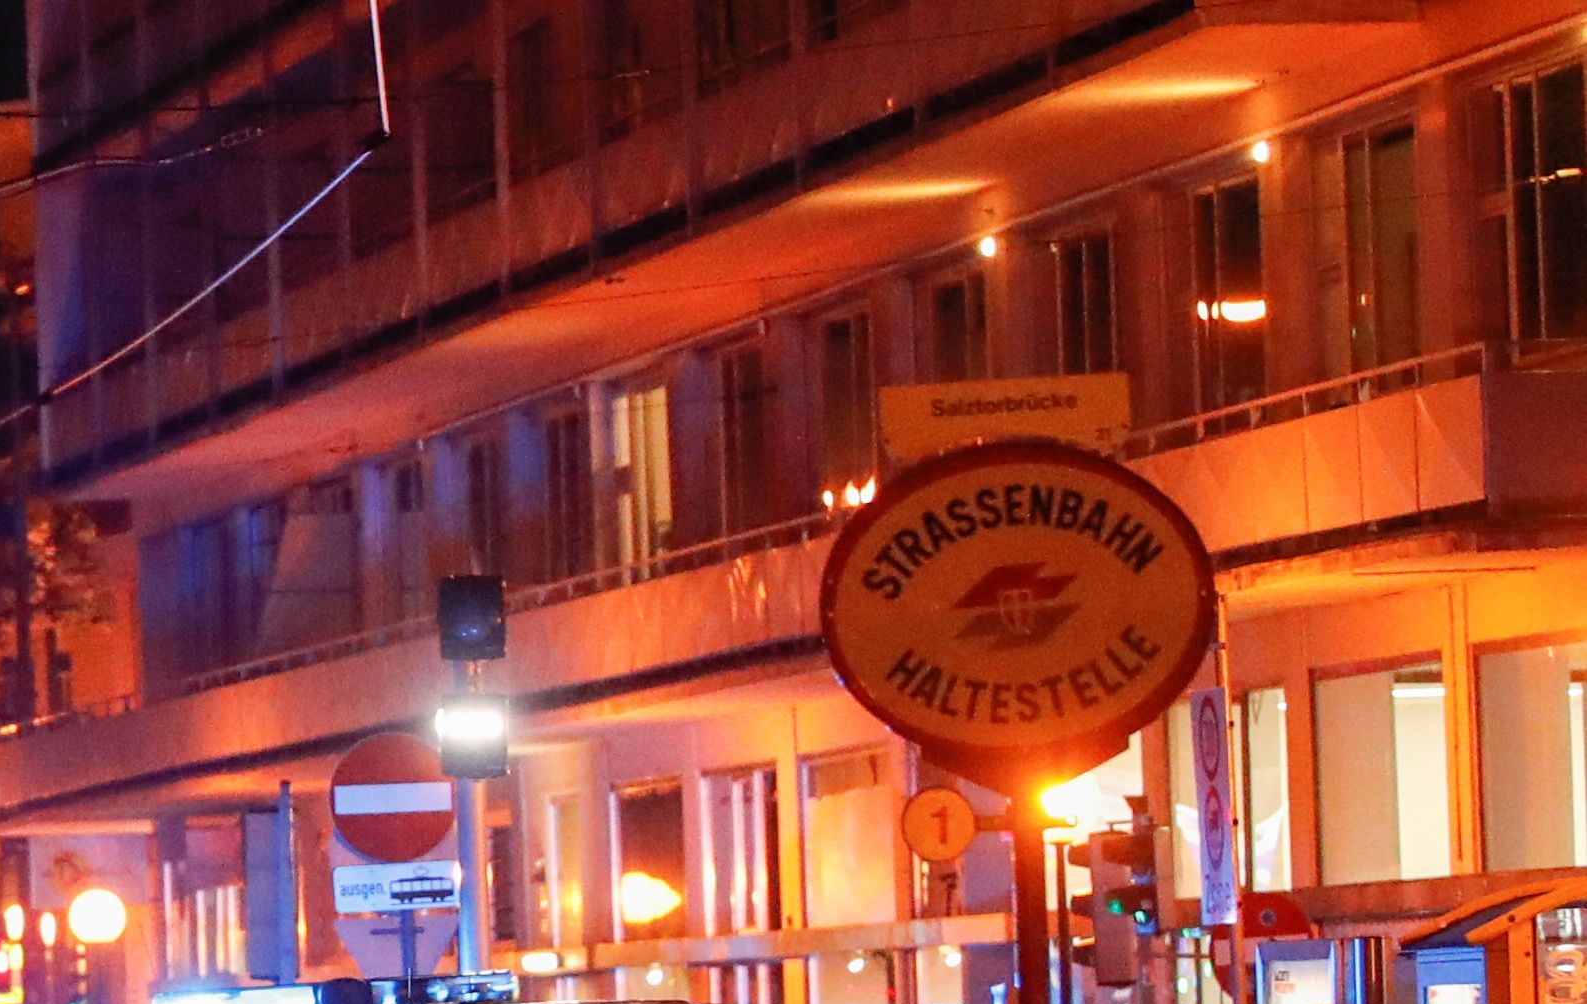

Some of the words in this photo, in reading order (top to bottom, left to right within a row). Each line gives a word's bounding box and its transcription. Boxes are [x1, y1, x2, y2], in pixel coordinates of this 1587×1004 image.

[930, 393, 1078, 418] Salztorbrücke
[862, 484, 1164, 600] STRASSENBAHN
[884, 623, 1162, 725] HALTESTELLE
